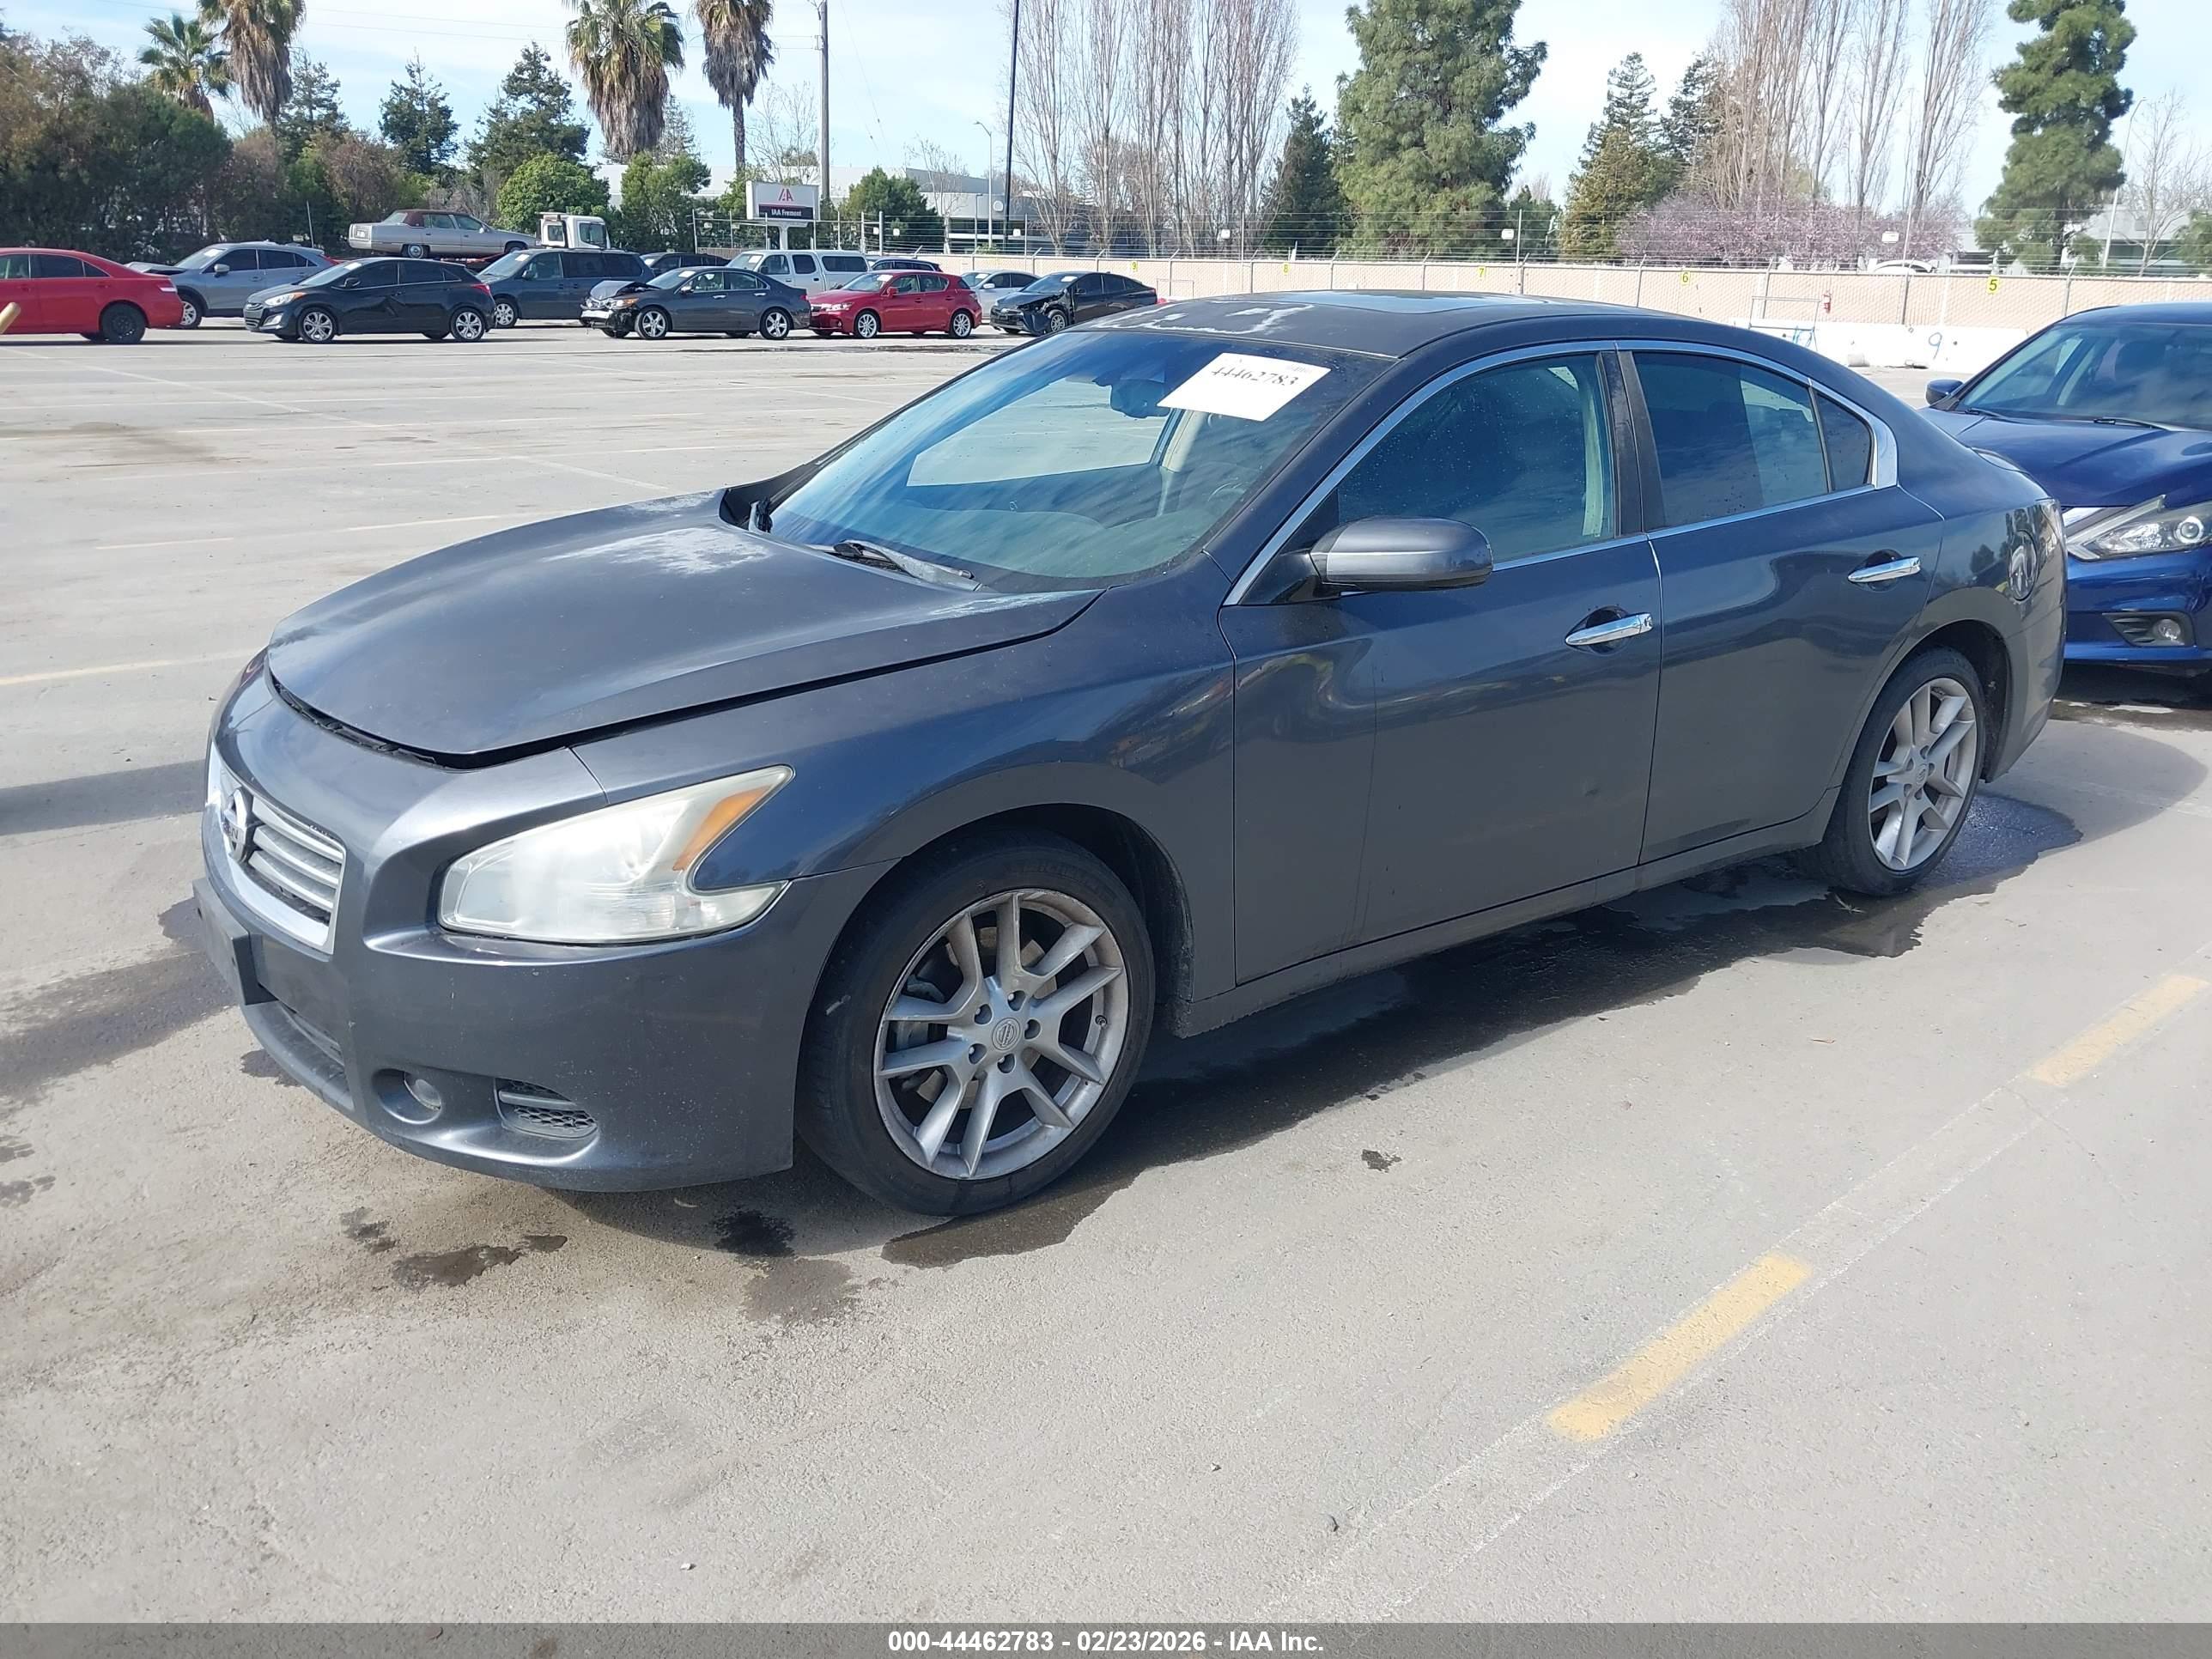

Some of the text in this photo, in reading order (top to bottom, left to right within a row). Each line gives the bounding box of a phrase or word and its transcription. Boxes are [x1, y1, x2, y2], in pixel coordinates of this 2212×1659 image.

[1990, 279, 1998, 291] 5
[1929, 331, 1943, 360] 9
[1211, 366, 1299, 386] 44462783
